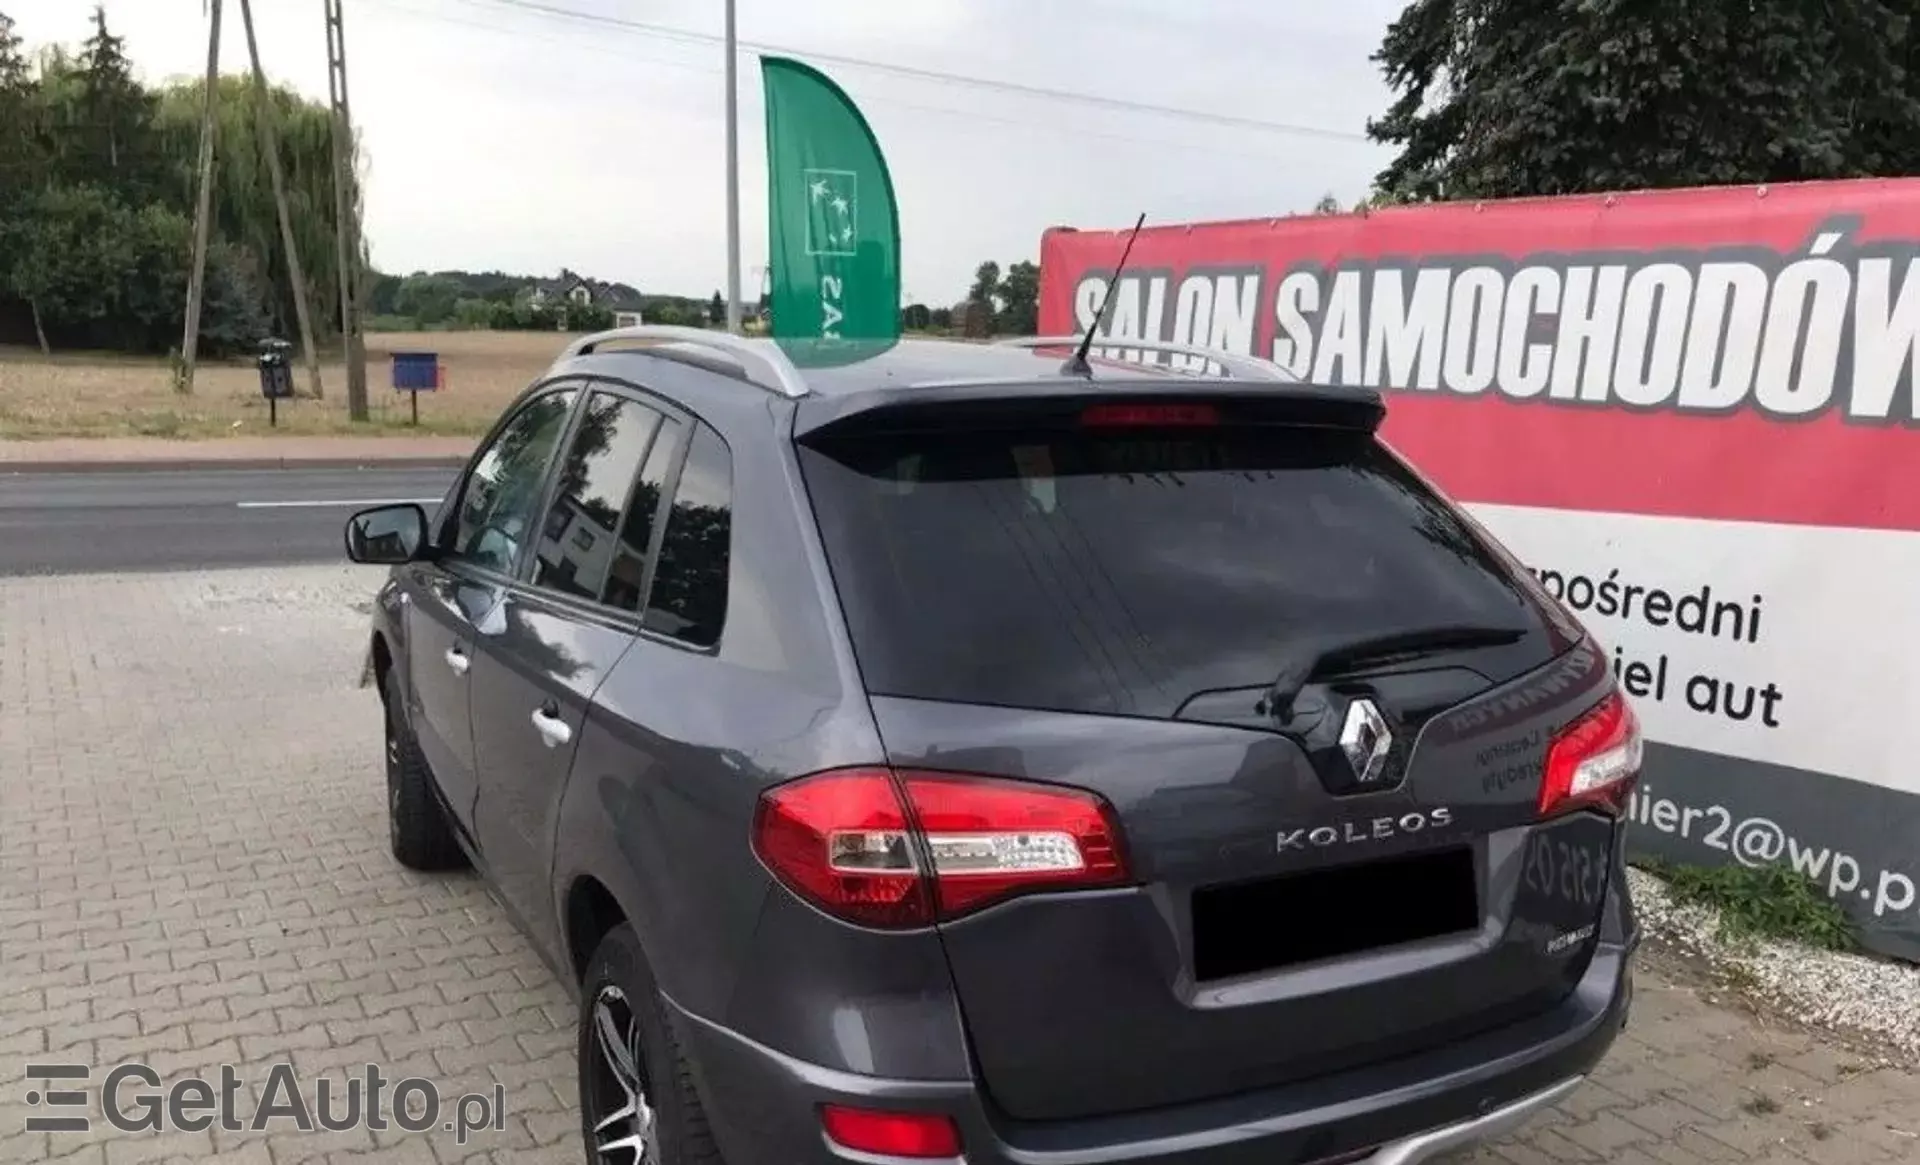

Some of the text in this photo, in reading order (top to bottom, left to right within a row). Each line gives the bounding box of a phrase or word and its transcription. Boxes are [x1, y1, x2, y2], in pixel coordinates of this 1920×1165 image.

[1074, 232, 1920, 420] SALON SAMOCHODÓW
[1526, 567, 1762, 643] pośredni
[1686, 675, 1783, 728] aut
[1276, 807, 1453, 853] KOLEOS
[1629, 784, 1920, 917] ier2@wp.p
